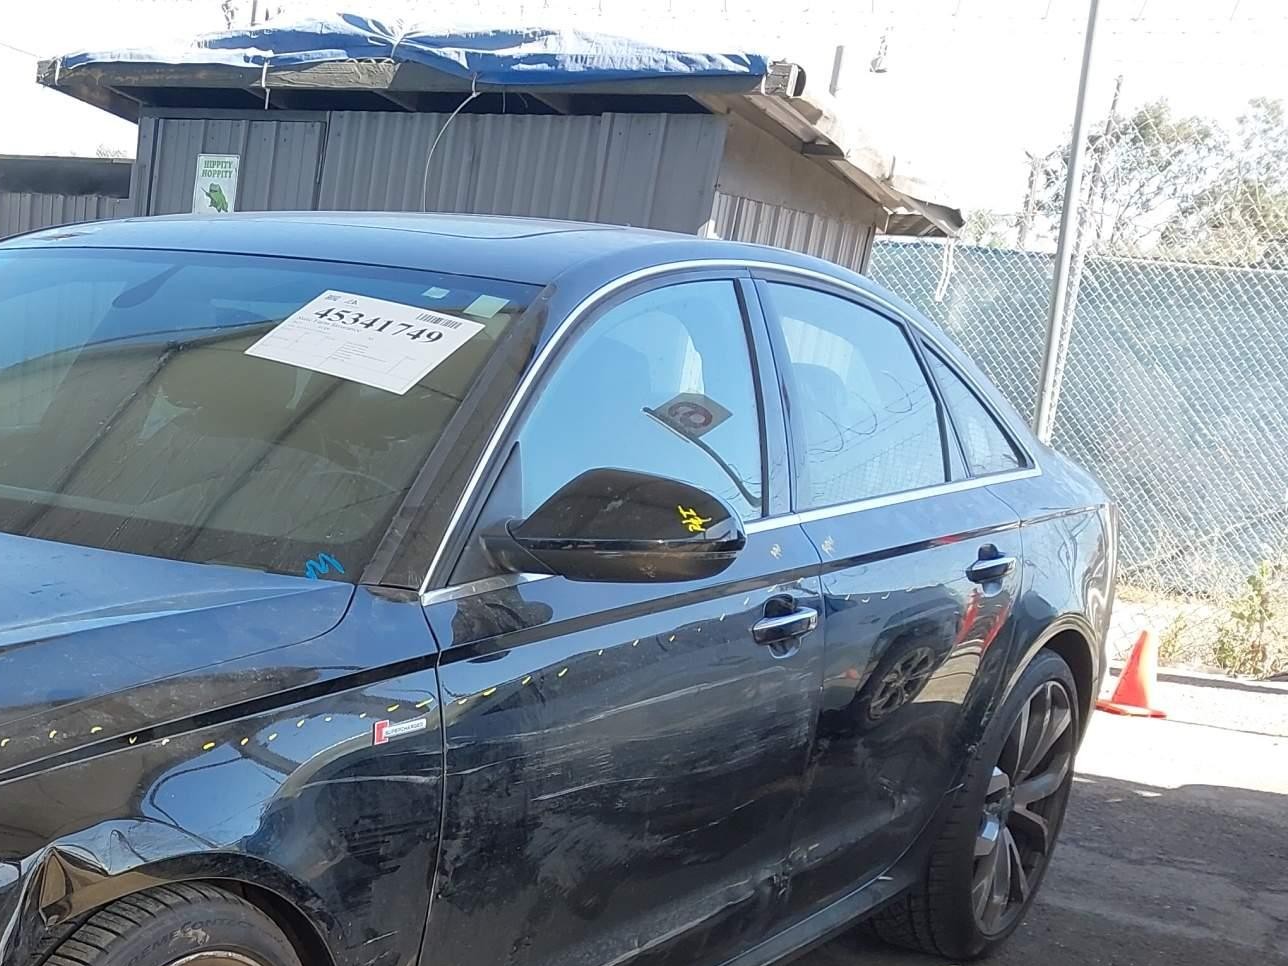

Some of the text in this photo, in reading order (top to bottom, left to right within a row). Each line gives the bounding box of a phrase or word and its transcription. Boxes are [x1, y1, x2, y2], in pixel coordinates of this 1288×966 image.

[204, 160, 233, 169] HIPPITY
[201, 169, 232, 178] HOPPITY
[313, 307, 443, 343] 45341749
